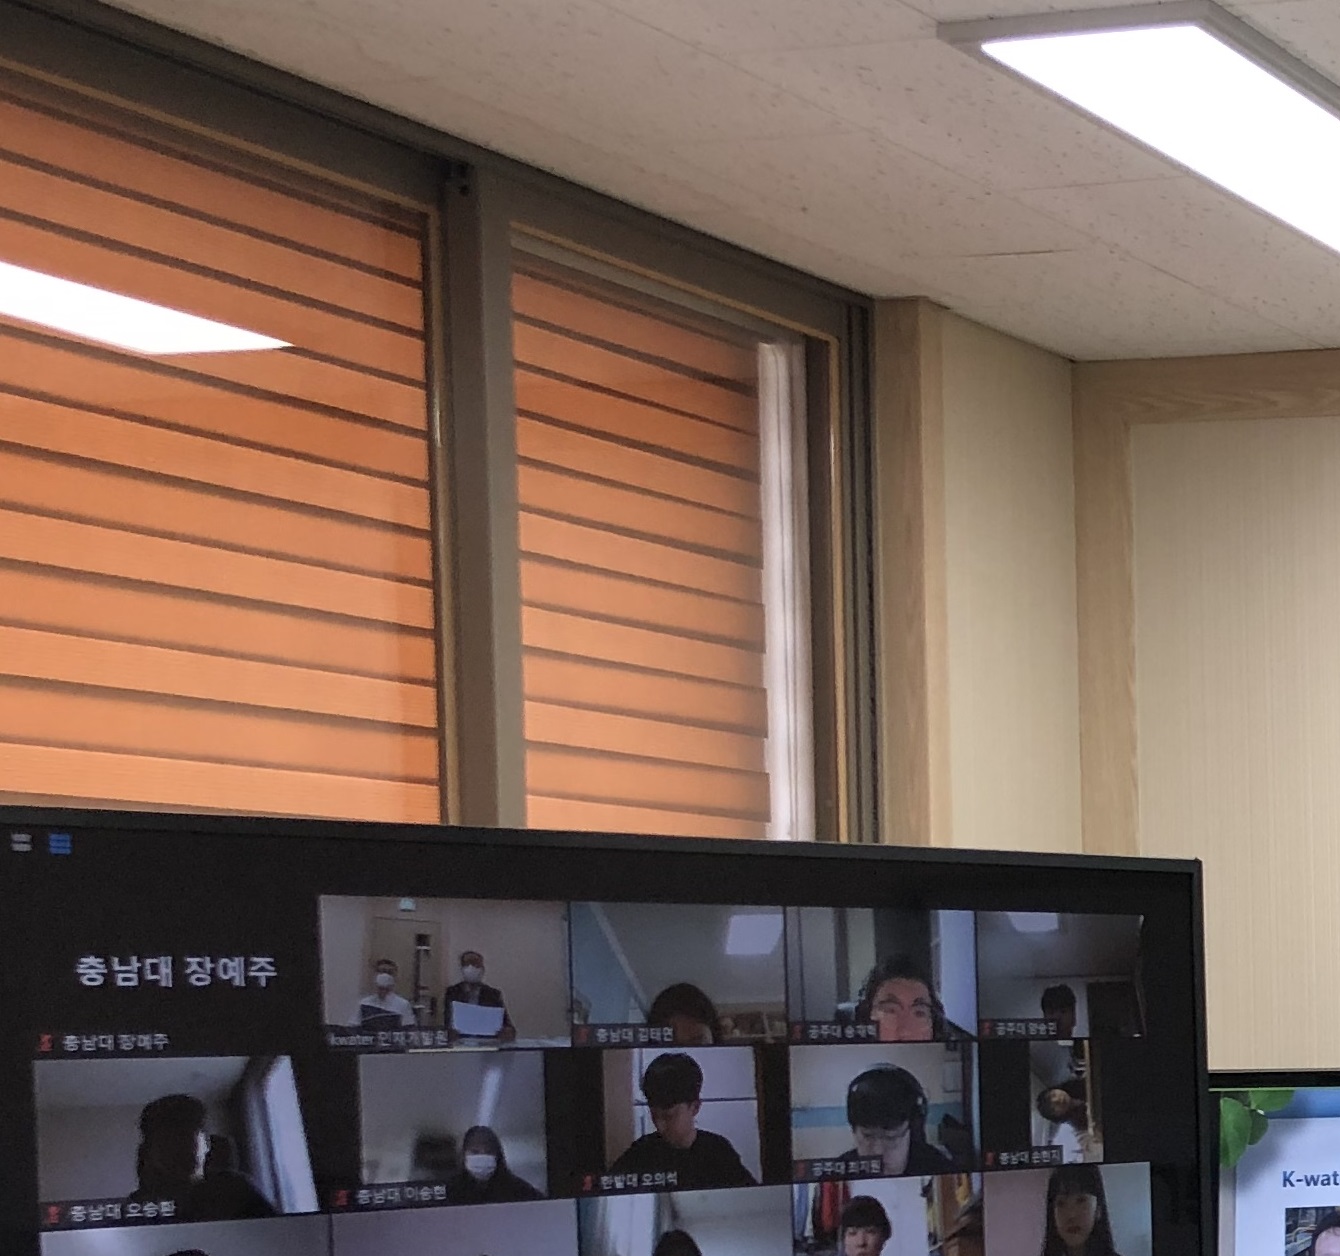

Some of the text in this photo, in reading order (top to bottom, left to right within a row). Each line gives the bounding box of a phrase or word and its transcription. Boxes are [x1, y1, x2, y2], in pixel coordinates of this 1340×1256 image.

[76, 955, 277, 988] 충남대 장예주
[63, 1035, 115, 1052] 충남대
[358, 1188, 401, 1206] 충남대
[70, 1203, 121, 1222] 충남대
